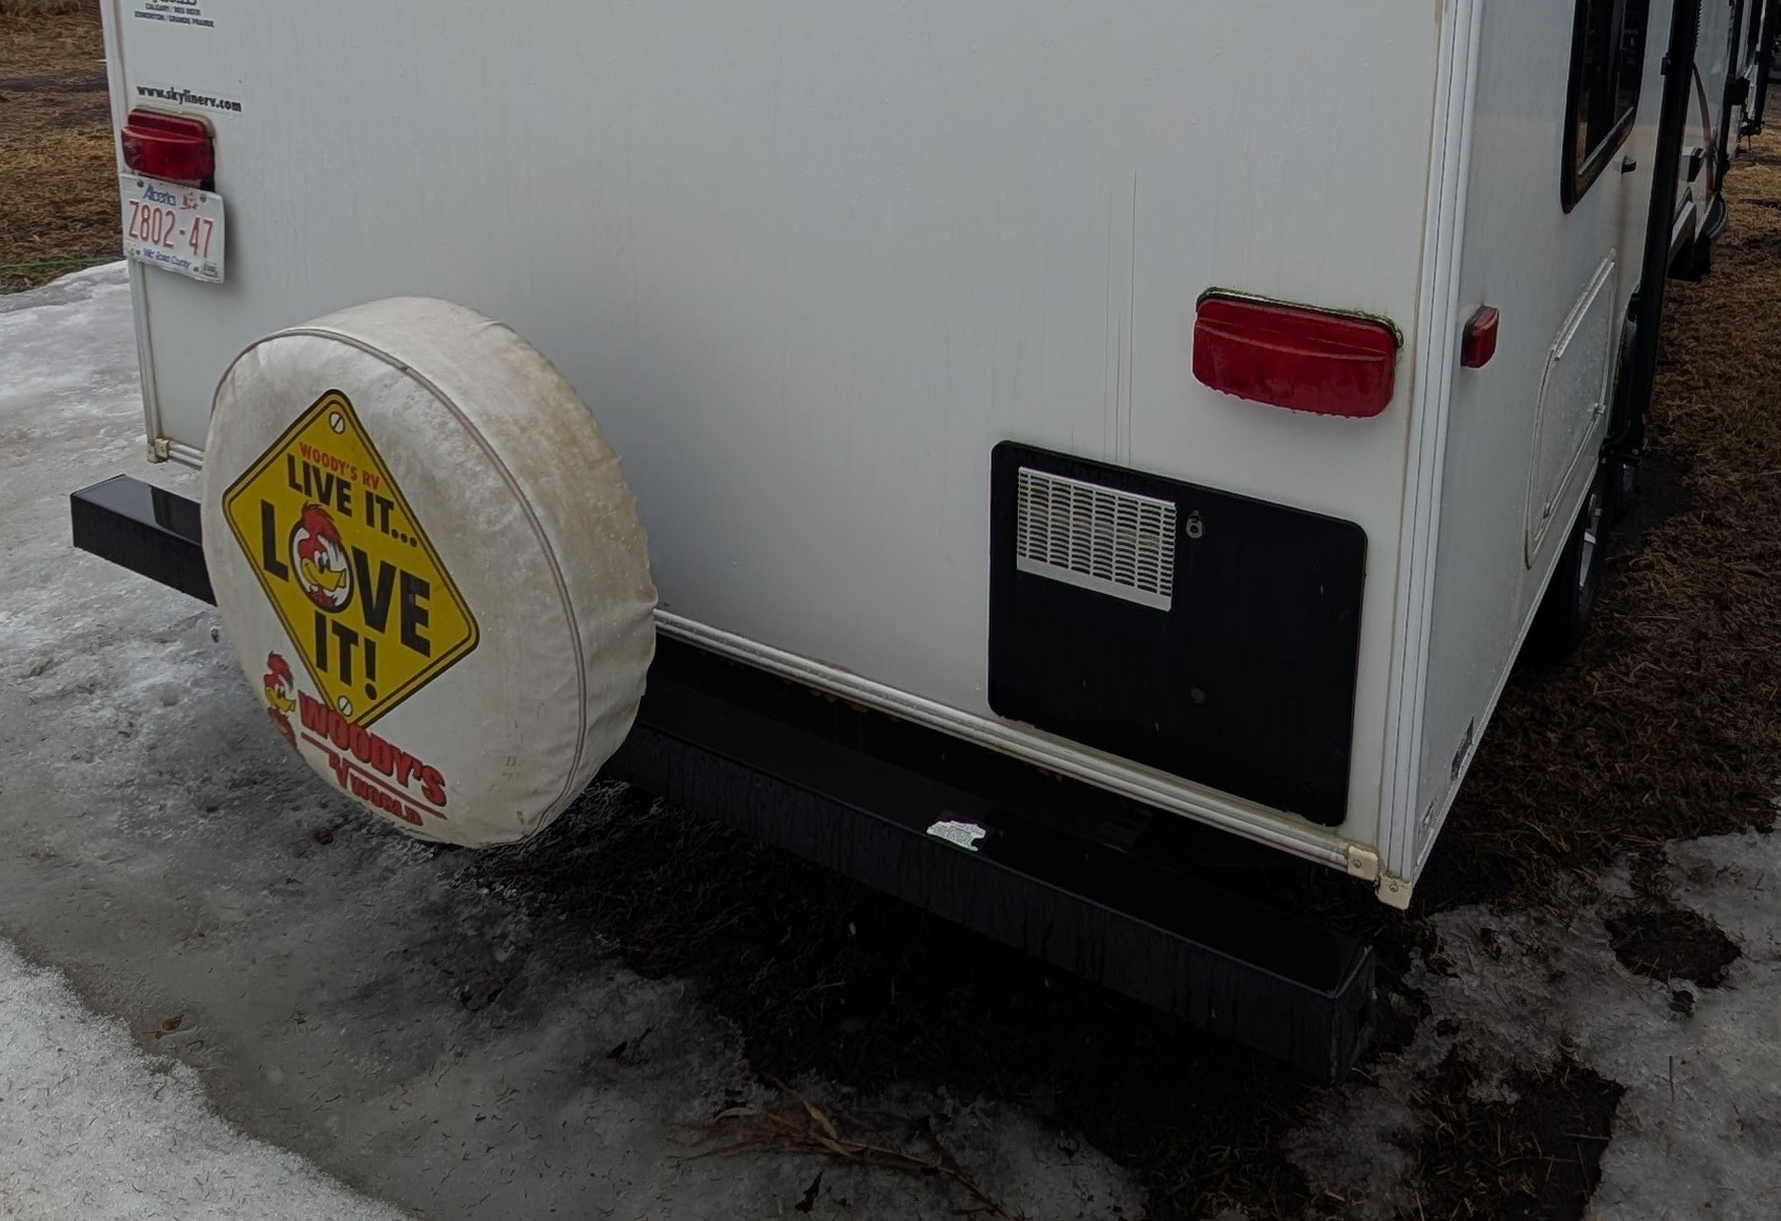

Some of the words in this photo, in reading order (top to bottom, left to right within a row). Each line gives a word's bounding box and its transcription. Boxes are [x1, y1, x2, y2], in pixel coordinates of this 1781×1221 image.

[136, 86, 242, 112] www.skylinerv.com
[129, 198, 214, 258] Z802-47
[287, 453, 352, 517] LIVE
[300, 442, 357, 481] WOODY'S
[362, 470, 380, 490] RV
[315, 610, 377, 700] IT!
[297, 689, 447, 806] WOODY'S
